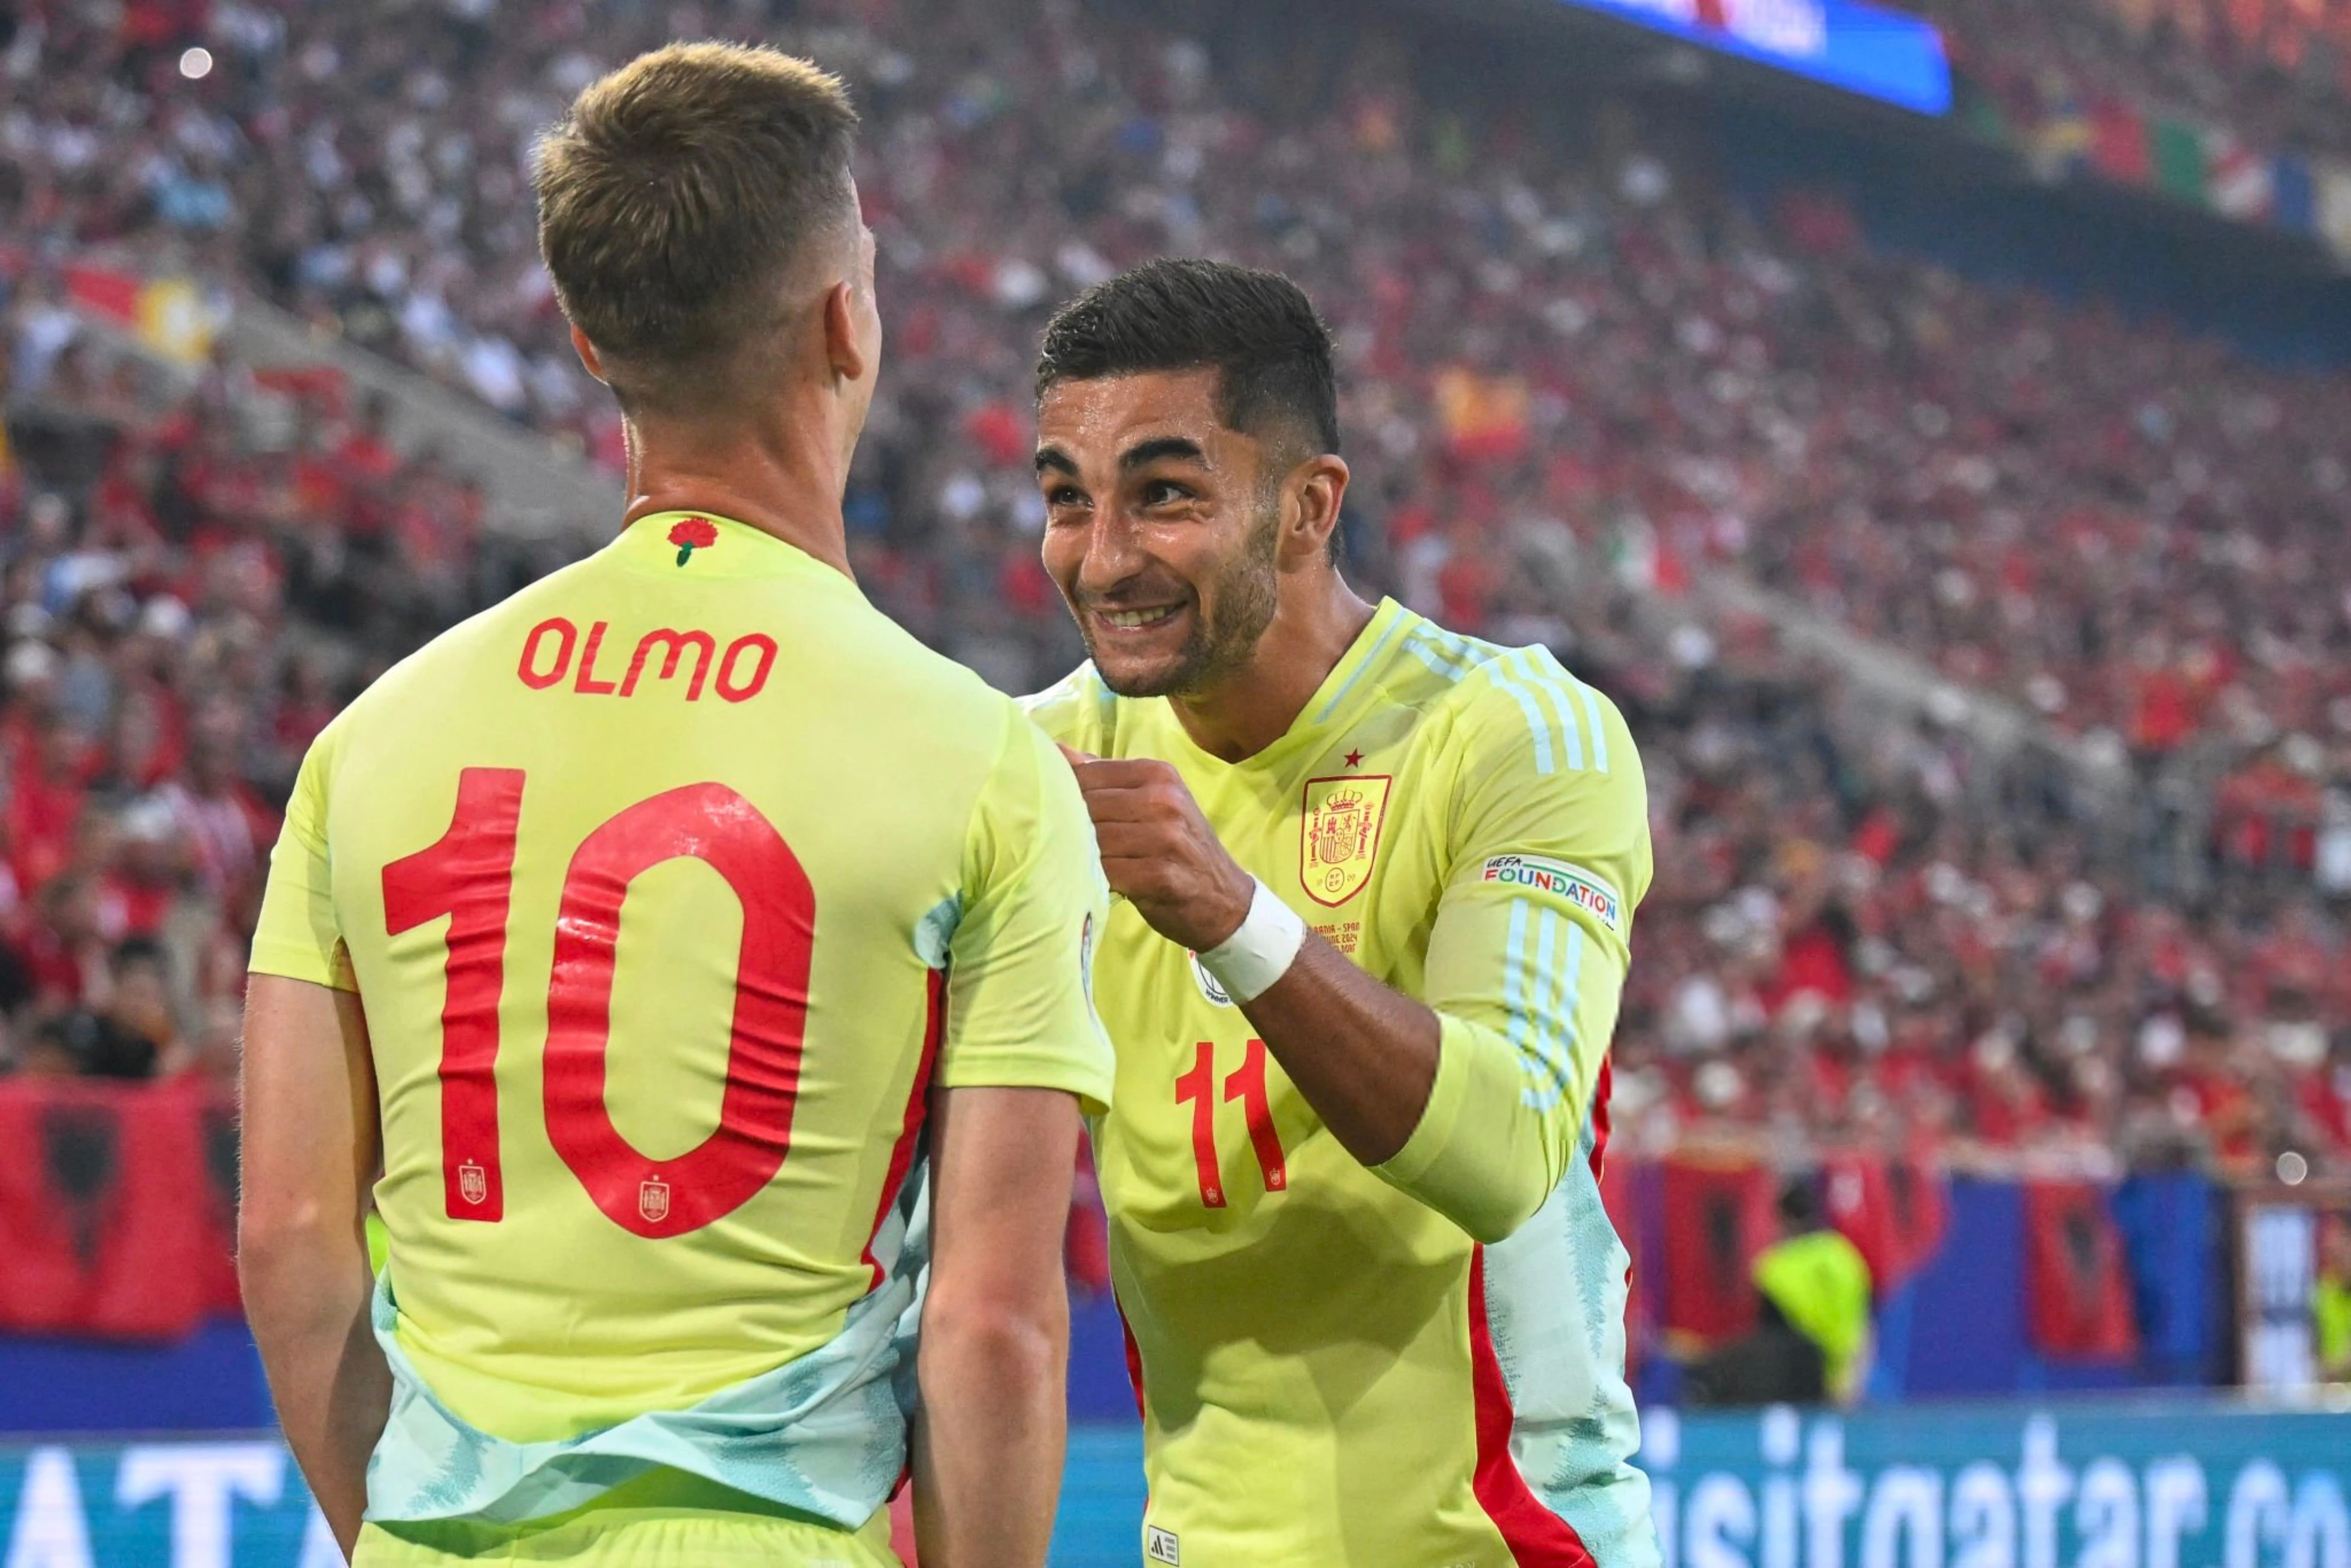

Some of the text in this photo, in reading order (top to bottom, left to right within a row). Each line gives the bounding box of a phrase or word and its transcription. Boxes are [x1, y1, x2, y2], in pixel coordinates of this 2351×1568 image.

[517, 616, 779, 703] OLMO
[1484, 868, 1616, 921] FOUNDATION
[1487, 856, 1522, 868] UEFA
[382, 767, 816, 1239] 10
[1175, 1039, 1287, 1208] 11
